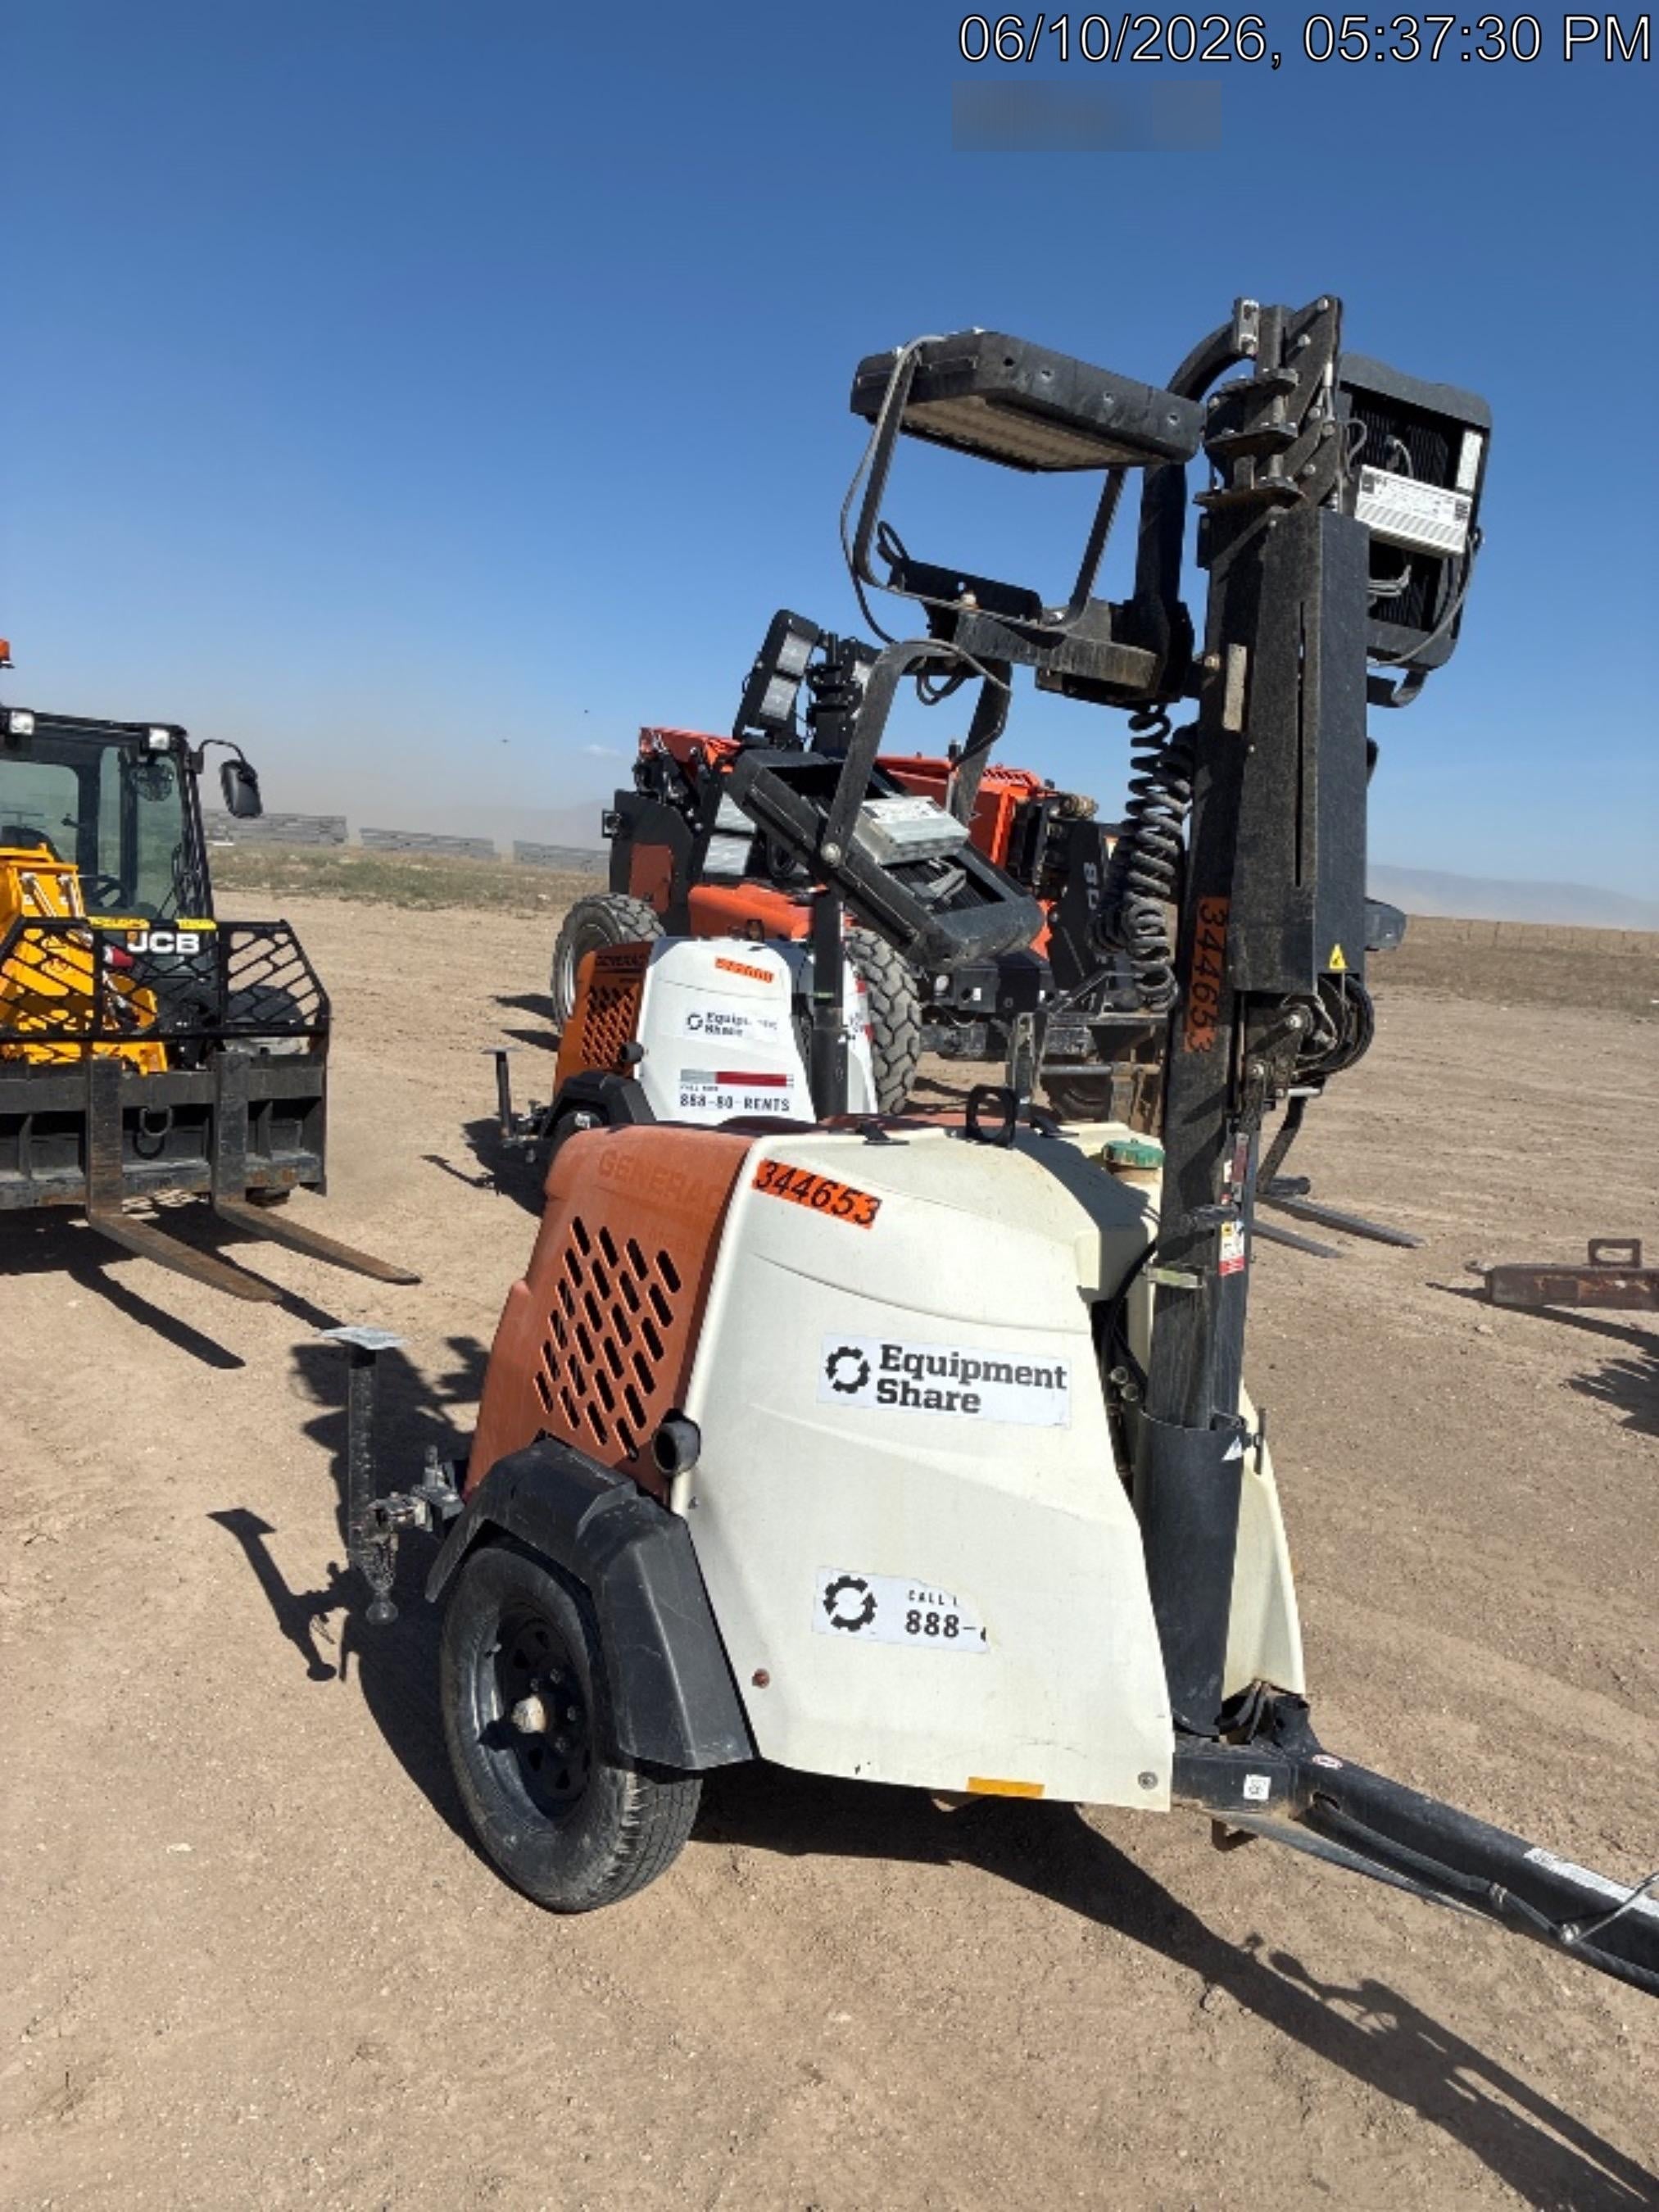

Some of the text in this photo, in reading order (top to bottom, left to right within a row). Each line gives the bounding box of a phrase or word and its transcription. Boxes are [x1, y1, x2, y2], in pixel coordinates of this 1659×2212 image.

[126, 931, 200, 954] JCB
[1188, 903, 1226, 1053] 344653
[755, 1160, 882, 1226] 344653
[879, 1344, 1067, 1391] Equipment
[876, 1377, 981, 1414] Share
[908, 1589, 945, 1607] CALL
[904, 1608, 986, 1643] 888-
